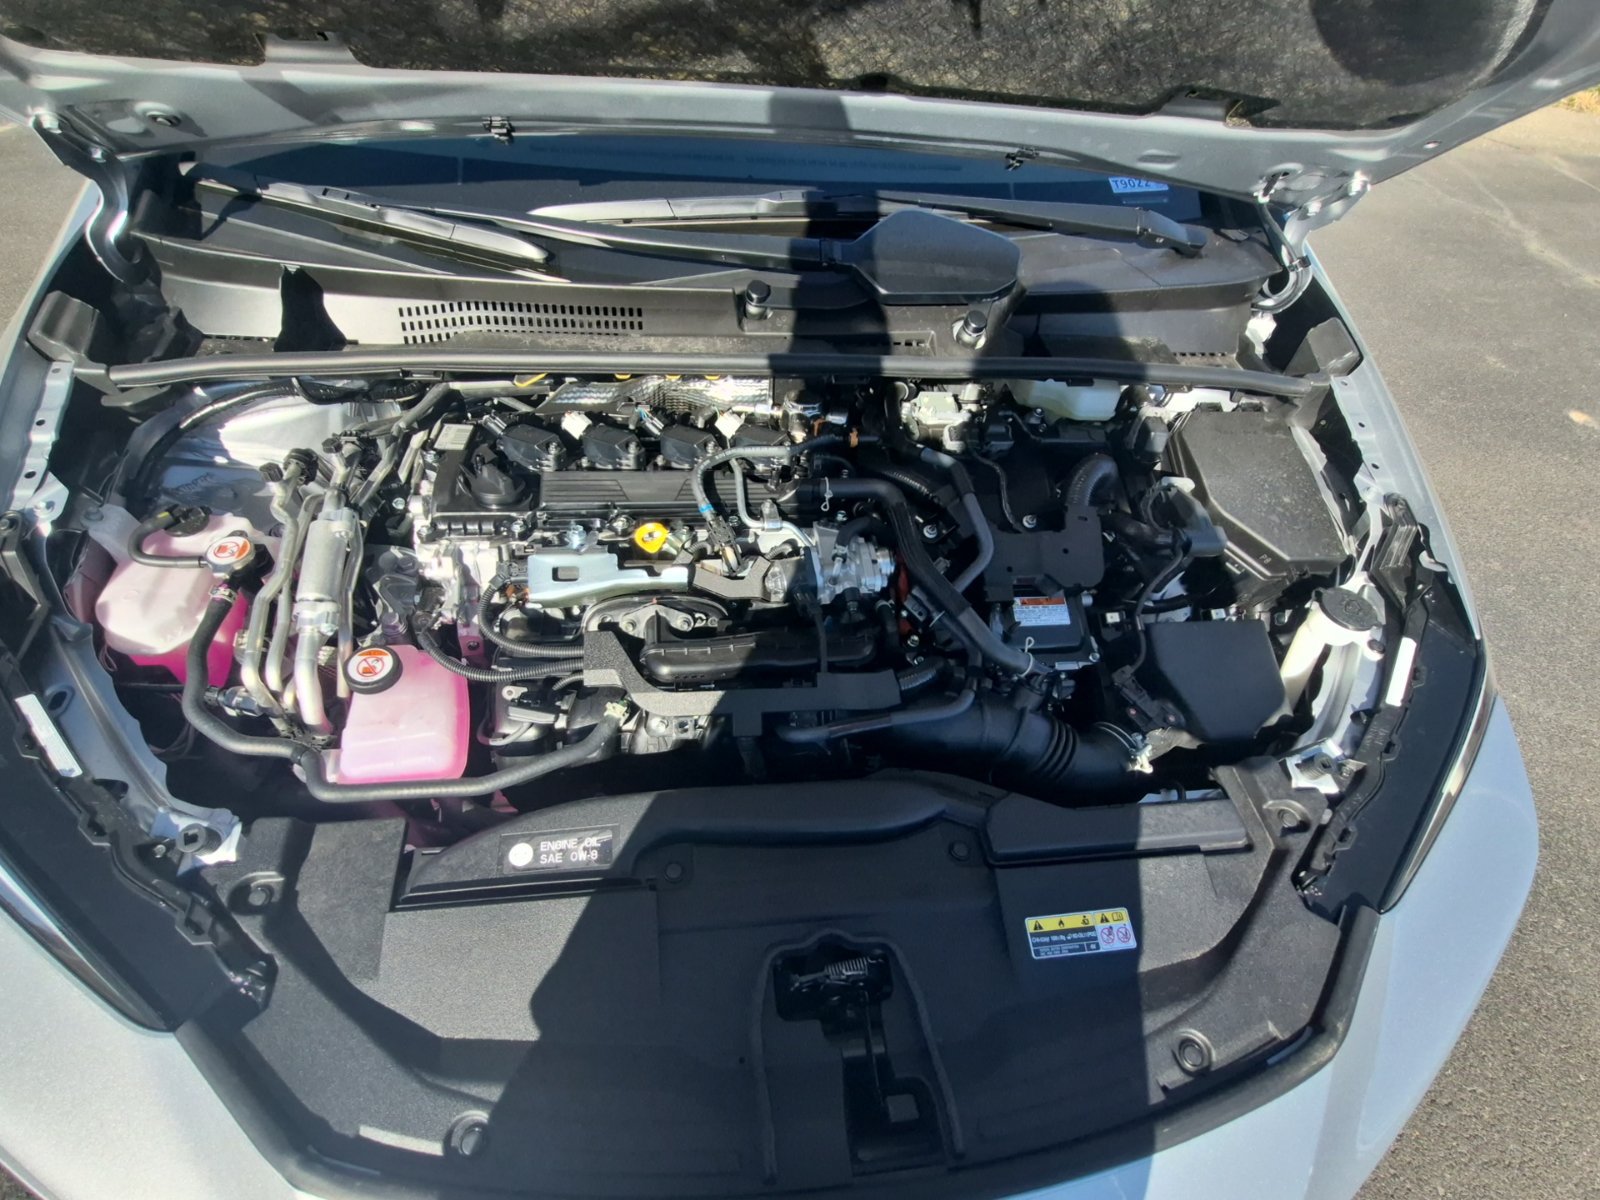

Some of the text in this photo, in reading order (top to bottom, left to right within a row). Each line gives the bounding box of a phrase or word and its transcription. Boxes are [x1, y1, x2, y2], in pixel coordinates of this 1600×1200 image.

[540, 838, 601, 851] ENGINE OIL
[540, 853, 563, 864] SAE
